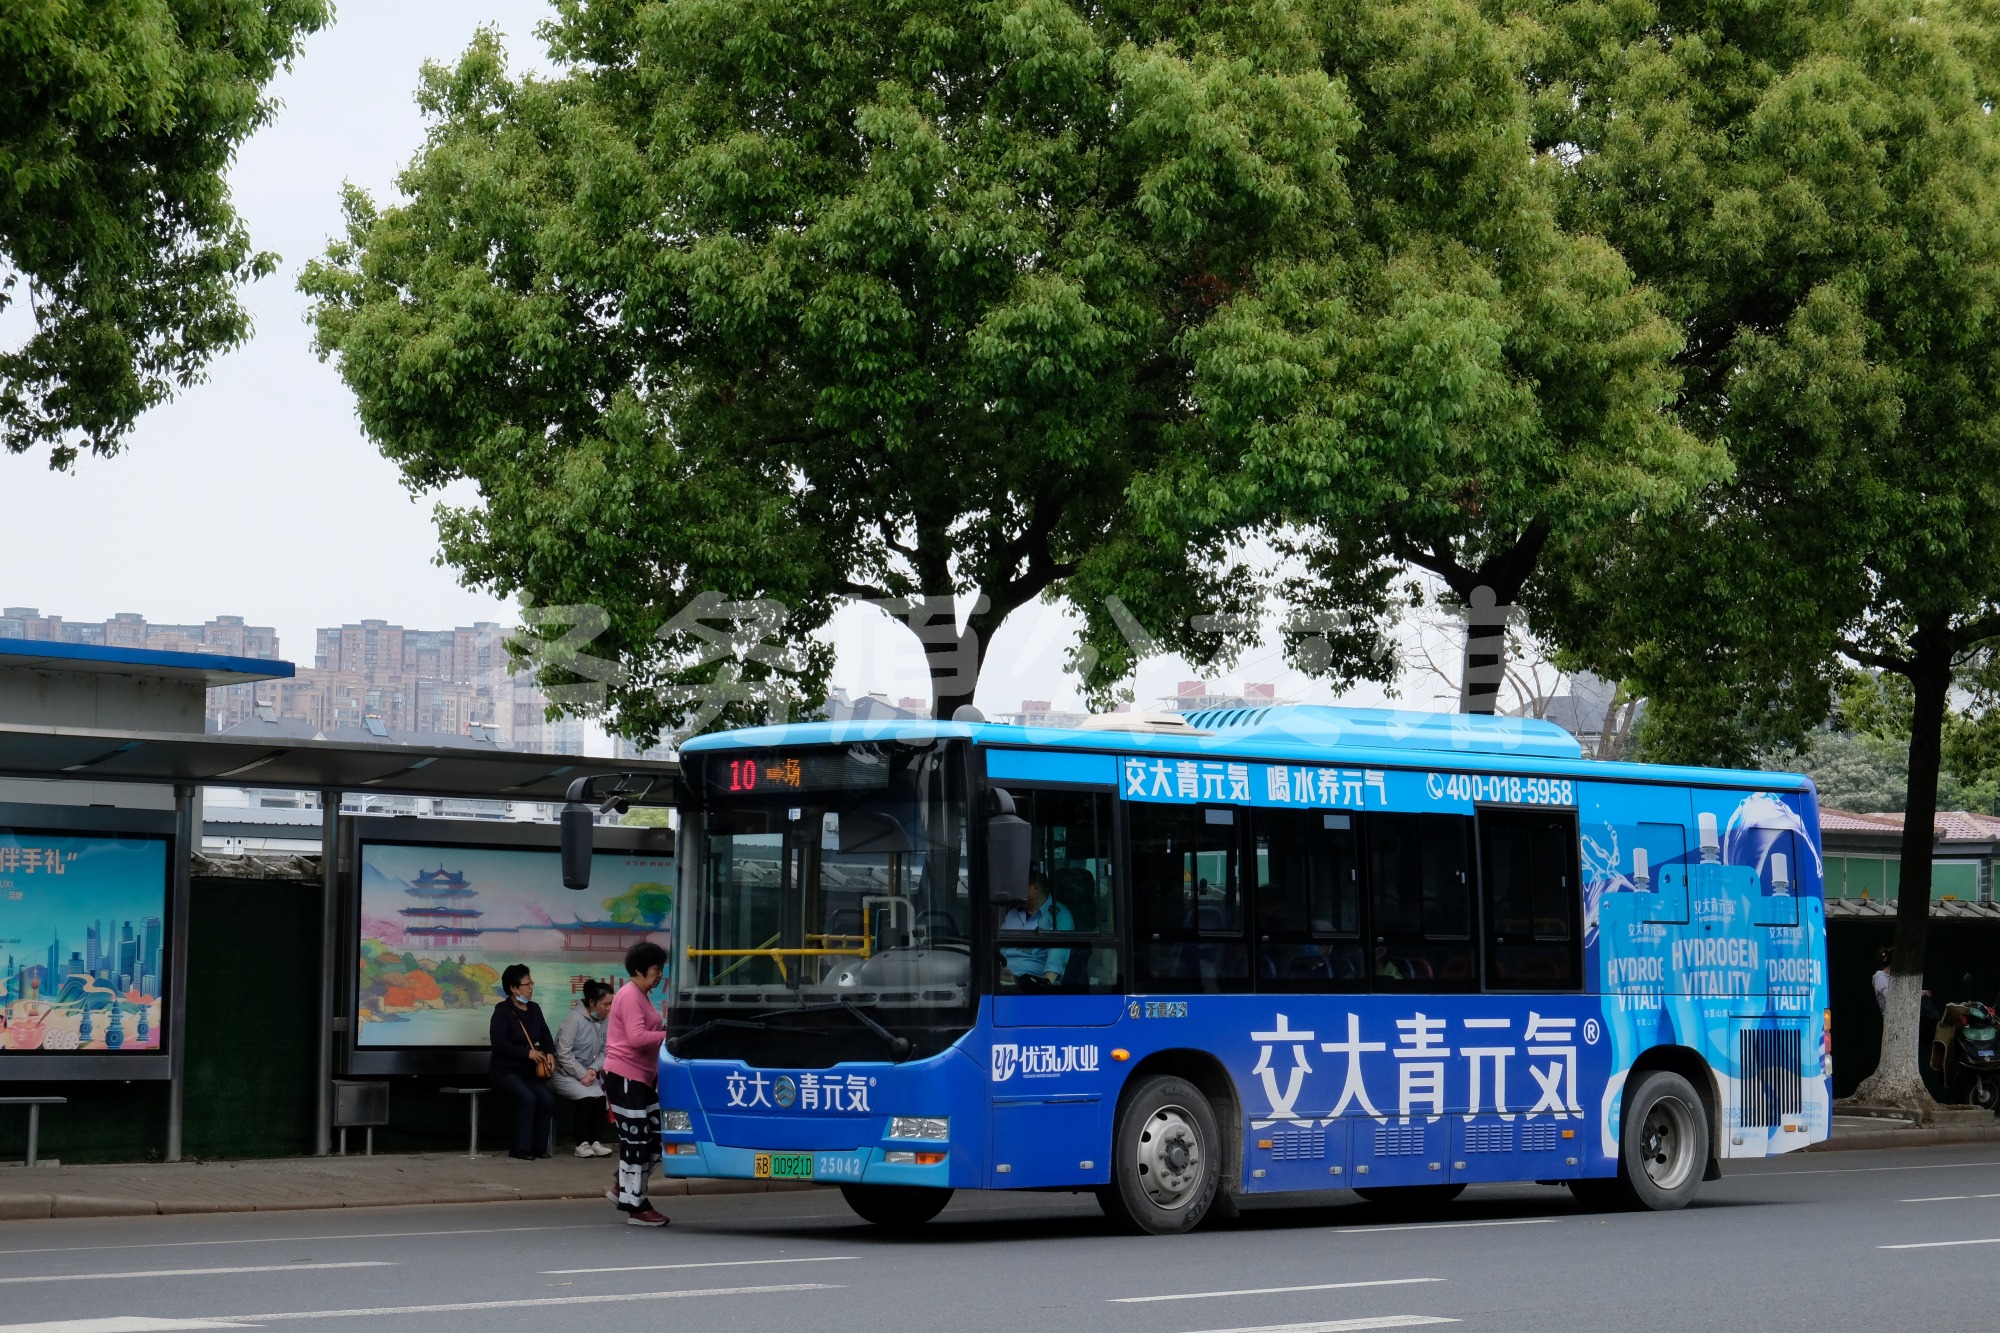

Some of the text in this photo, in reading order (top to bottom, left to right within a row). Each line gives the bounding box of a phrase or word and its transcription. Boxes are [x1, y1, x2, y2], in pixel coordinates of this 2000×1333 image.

[730, 760, 756, 790] 10
[1266, 765, 1387, 806] 喝水养元气
[1446, 774, 1573, 805] 400-018-5958
[0, 880, 14, 889] UXI
[1671, 937, 1759, 971] HYDROGEN
[1681, 970, 1751, 1002] VITALITY
[1765, 958, 1821, 985] DROGEN
[1616, 985, 1664, 1012] VITALI
[726, 1071, 772, 1108] 交大
[820, 1157, 860, 1175] 25042
